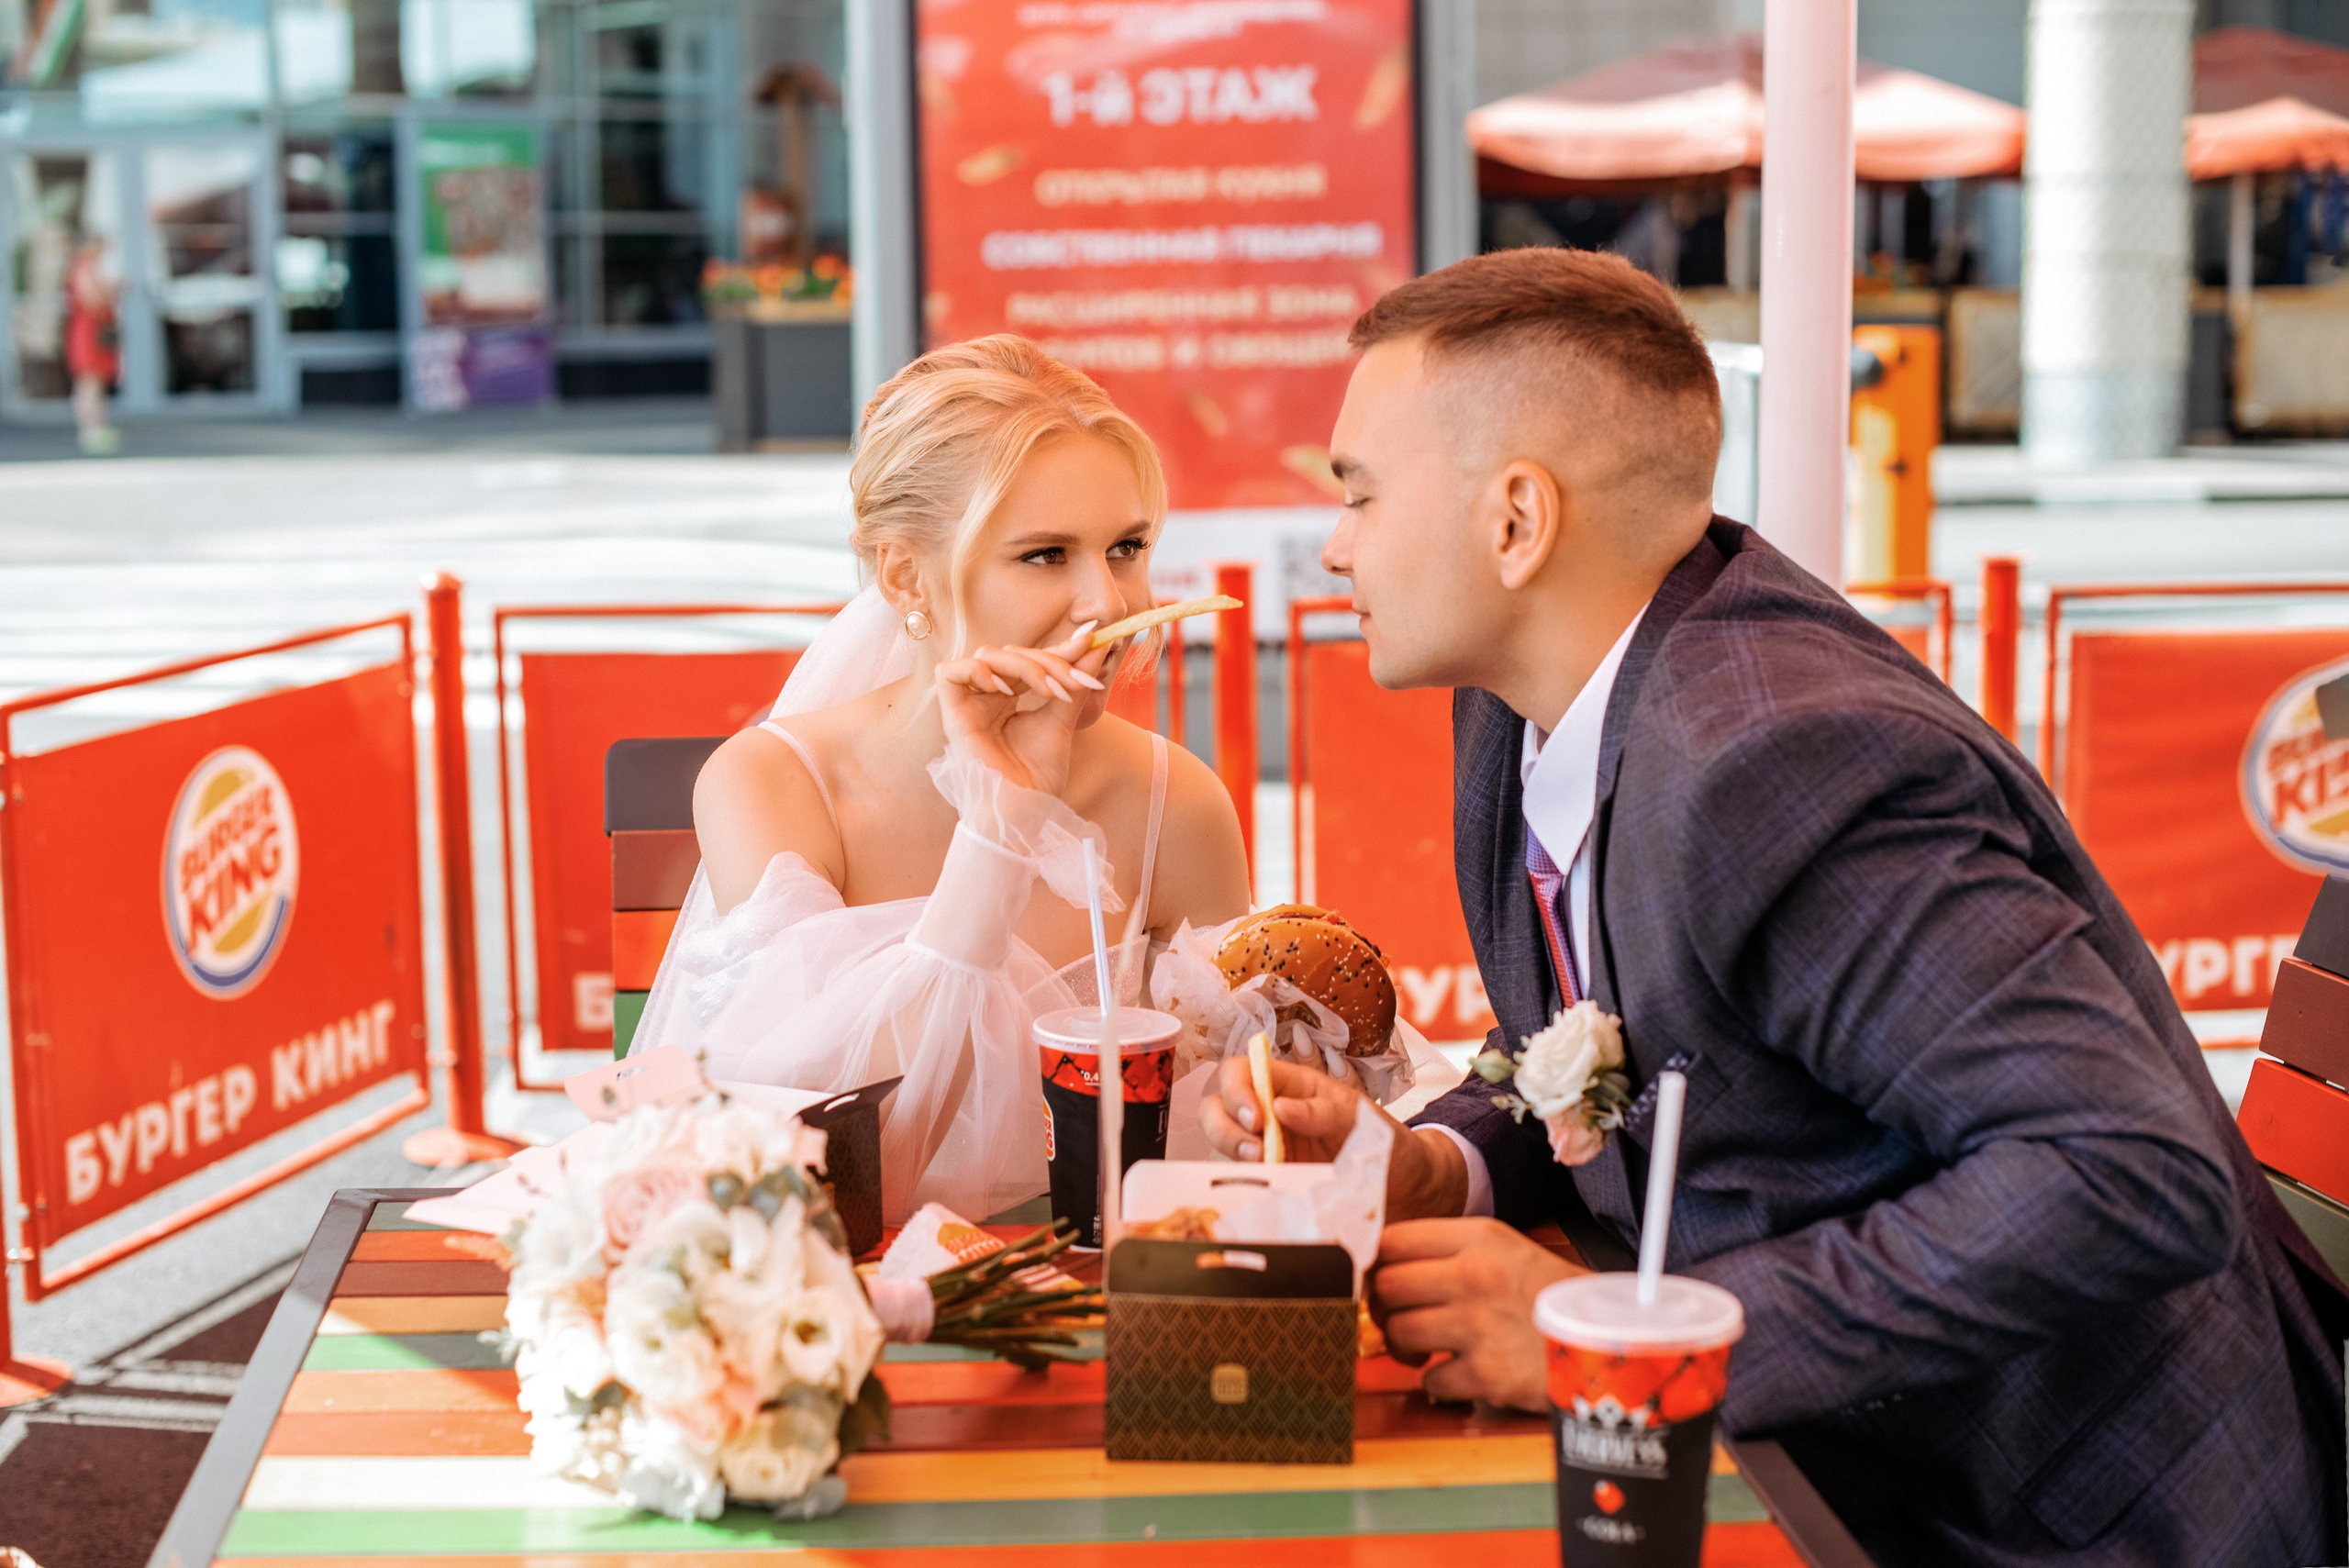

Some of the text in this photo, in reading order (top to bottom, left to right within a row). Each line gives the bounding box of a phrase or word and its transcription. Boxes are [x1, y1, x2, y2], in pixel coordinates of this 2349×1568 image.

[1140, 64, 1319, 126] ЭТАЖ
[981, 221, 1383, 270] СОБСТВЕННАЯ ПЕКАРНЯ
[182, 786, 273, 895] BURGER
[188, 824, 280, 954] KING
[65, 997, 395, 1206] БУРГЕР КИНГ
